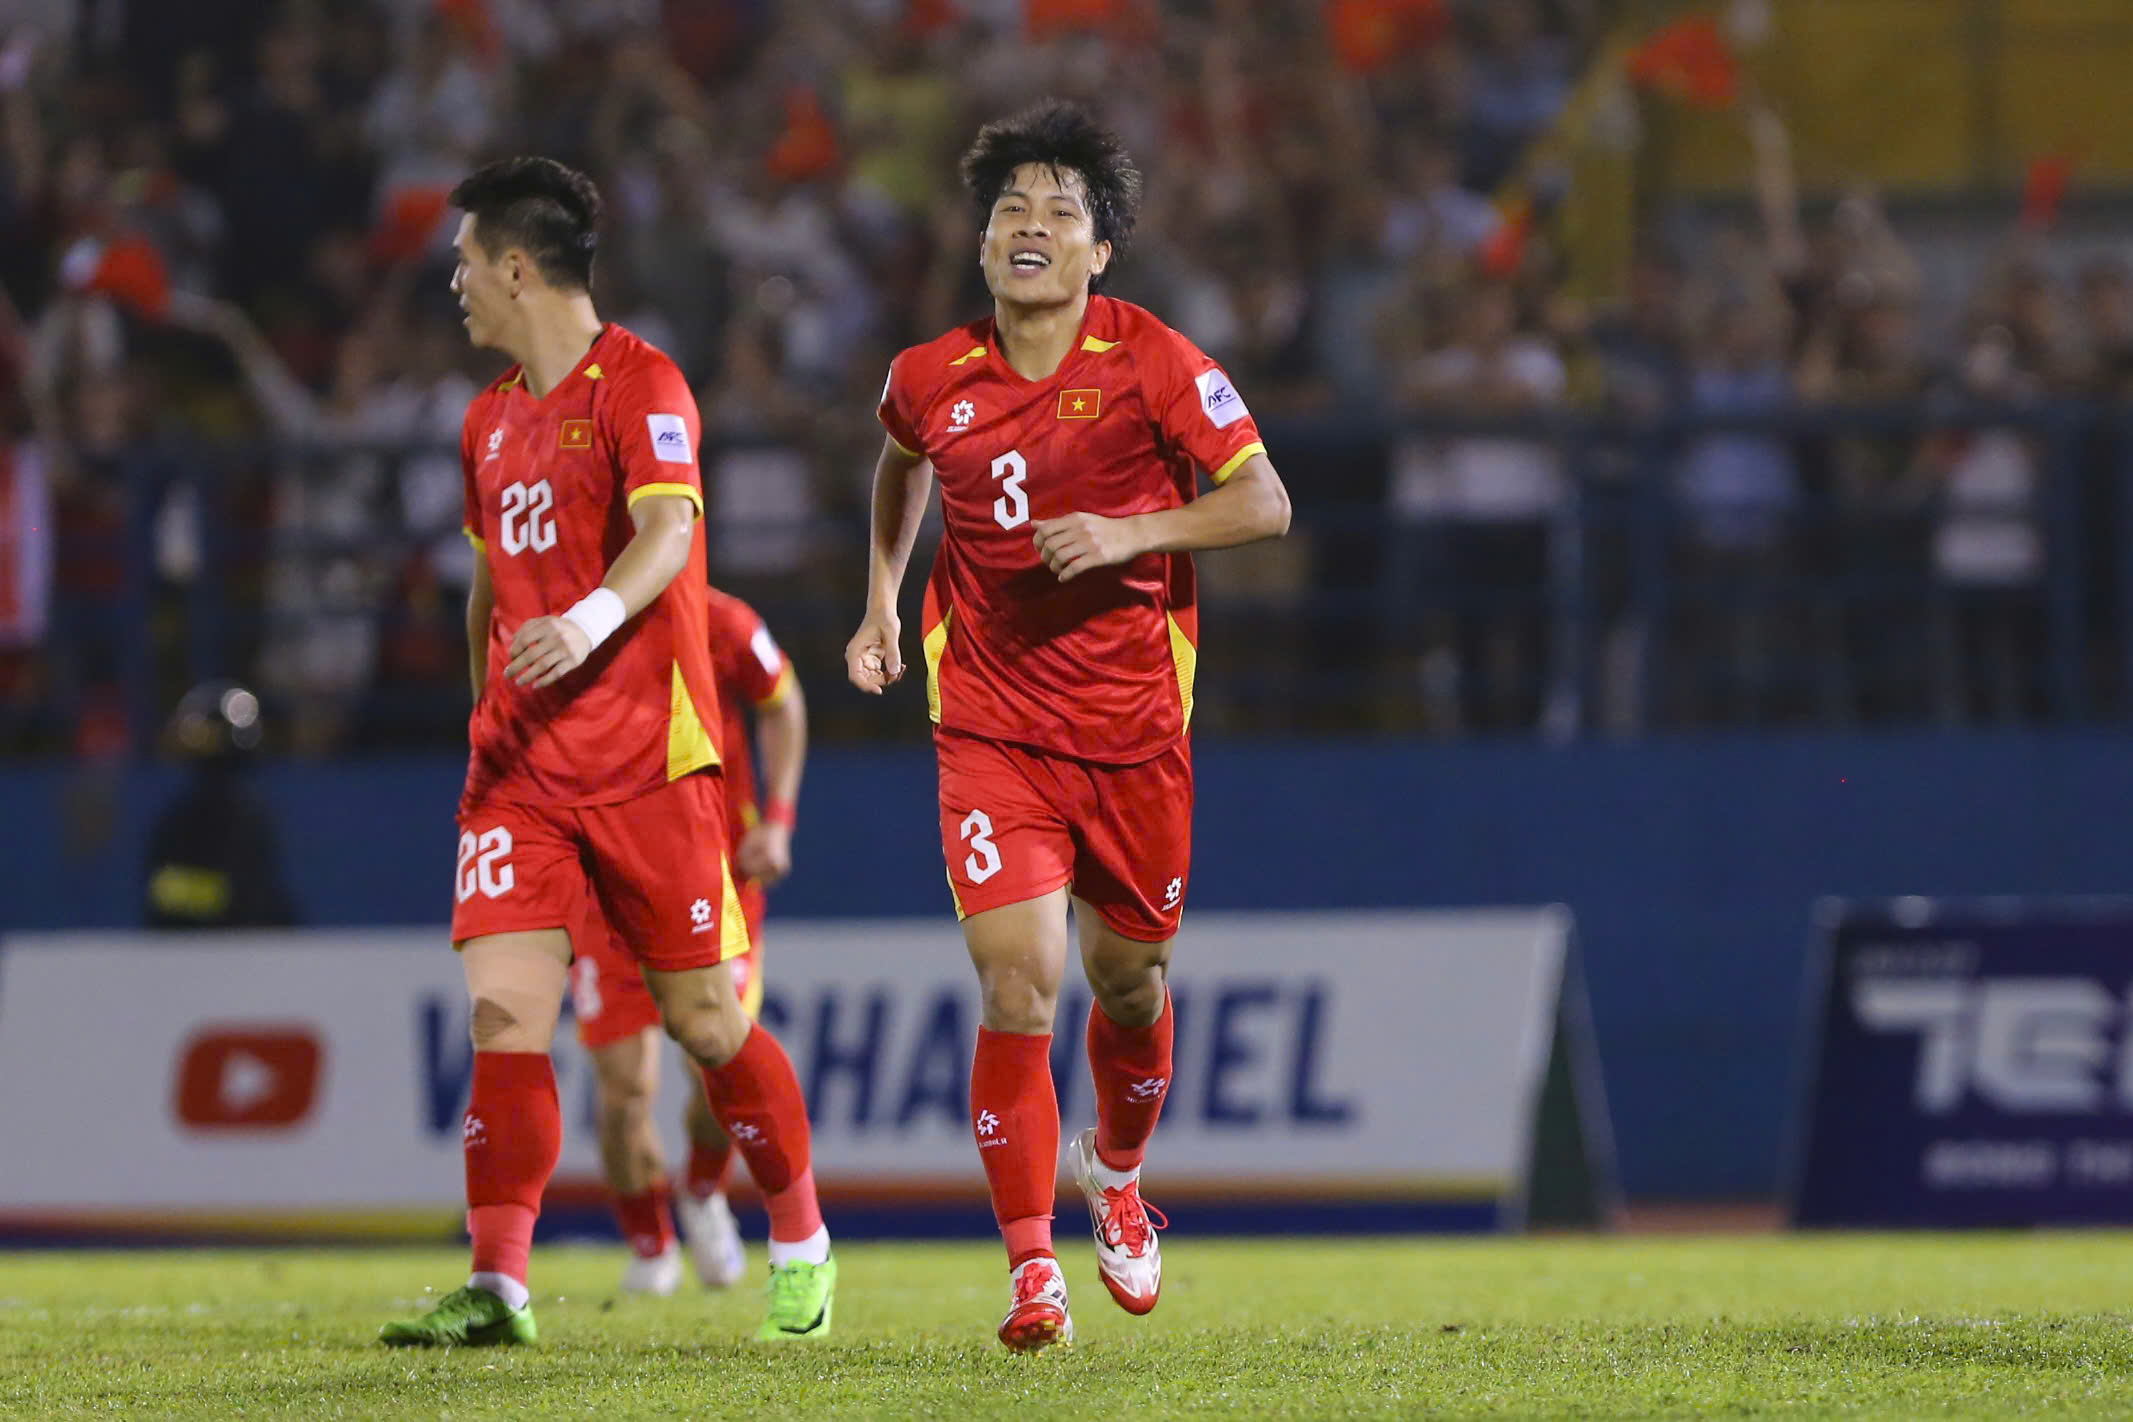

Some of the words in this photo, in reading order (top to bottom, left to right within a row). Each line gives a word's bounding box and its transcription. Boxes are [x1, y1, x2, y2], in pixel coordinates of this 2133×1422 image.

[1208, 384, 1232, 409] AFC
[501, 478, 558, 557] 22
[991, 449, 1030, 532] 3
[455, 825, 515, 904] 22
[960, 808, 1003, 885] 3
